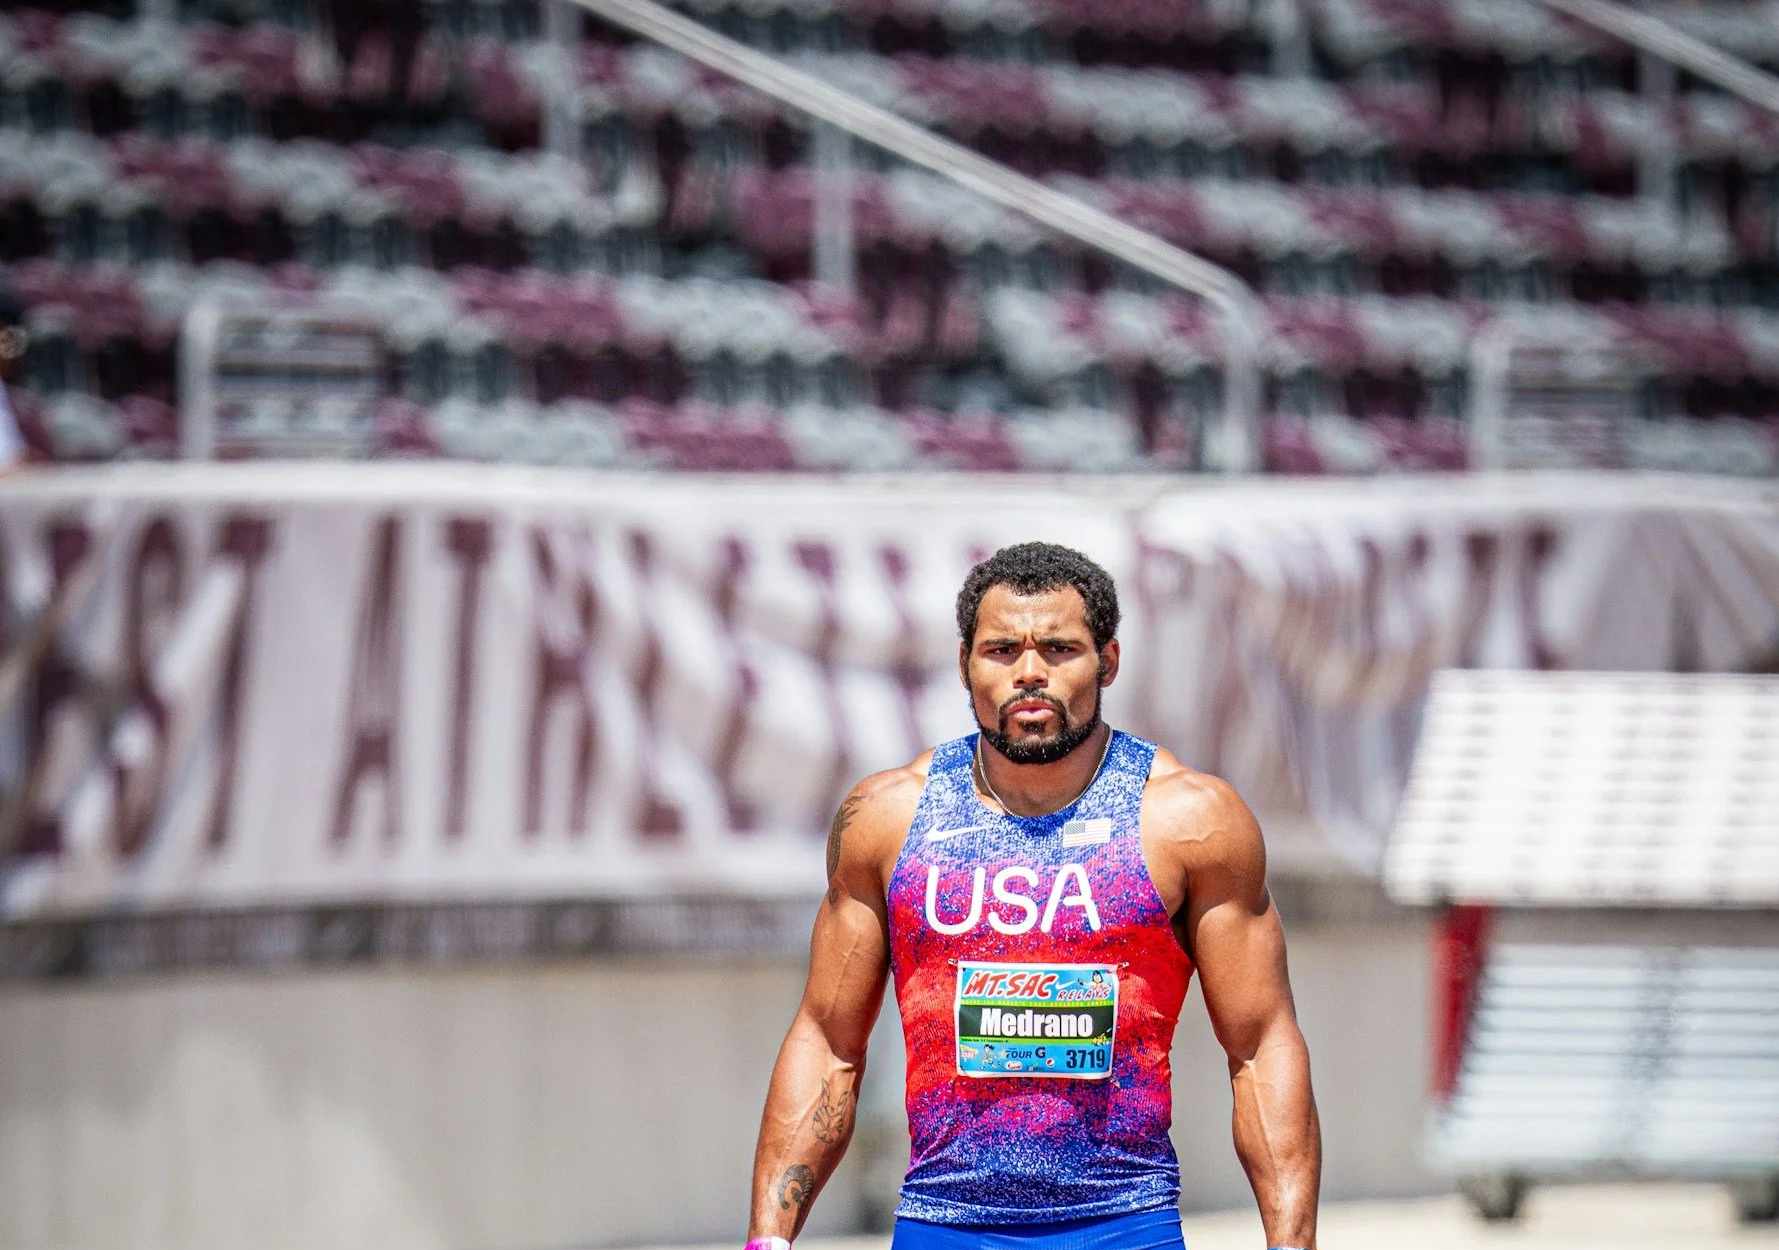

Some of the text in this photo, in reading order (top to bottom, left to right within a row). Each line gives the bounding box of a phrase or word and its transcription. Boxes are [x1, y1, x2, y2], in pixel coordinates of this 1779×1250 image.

[925, 863, 1102, 936] USA
[1057, 989, 1112, 1000] RELAYS
[979, 1008, 1094, 1038] Medrano
[1065, 1049, 1106, 1069] 3719
